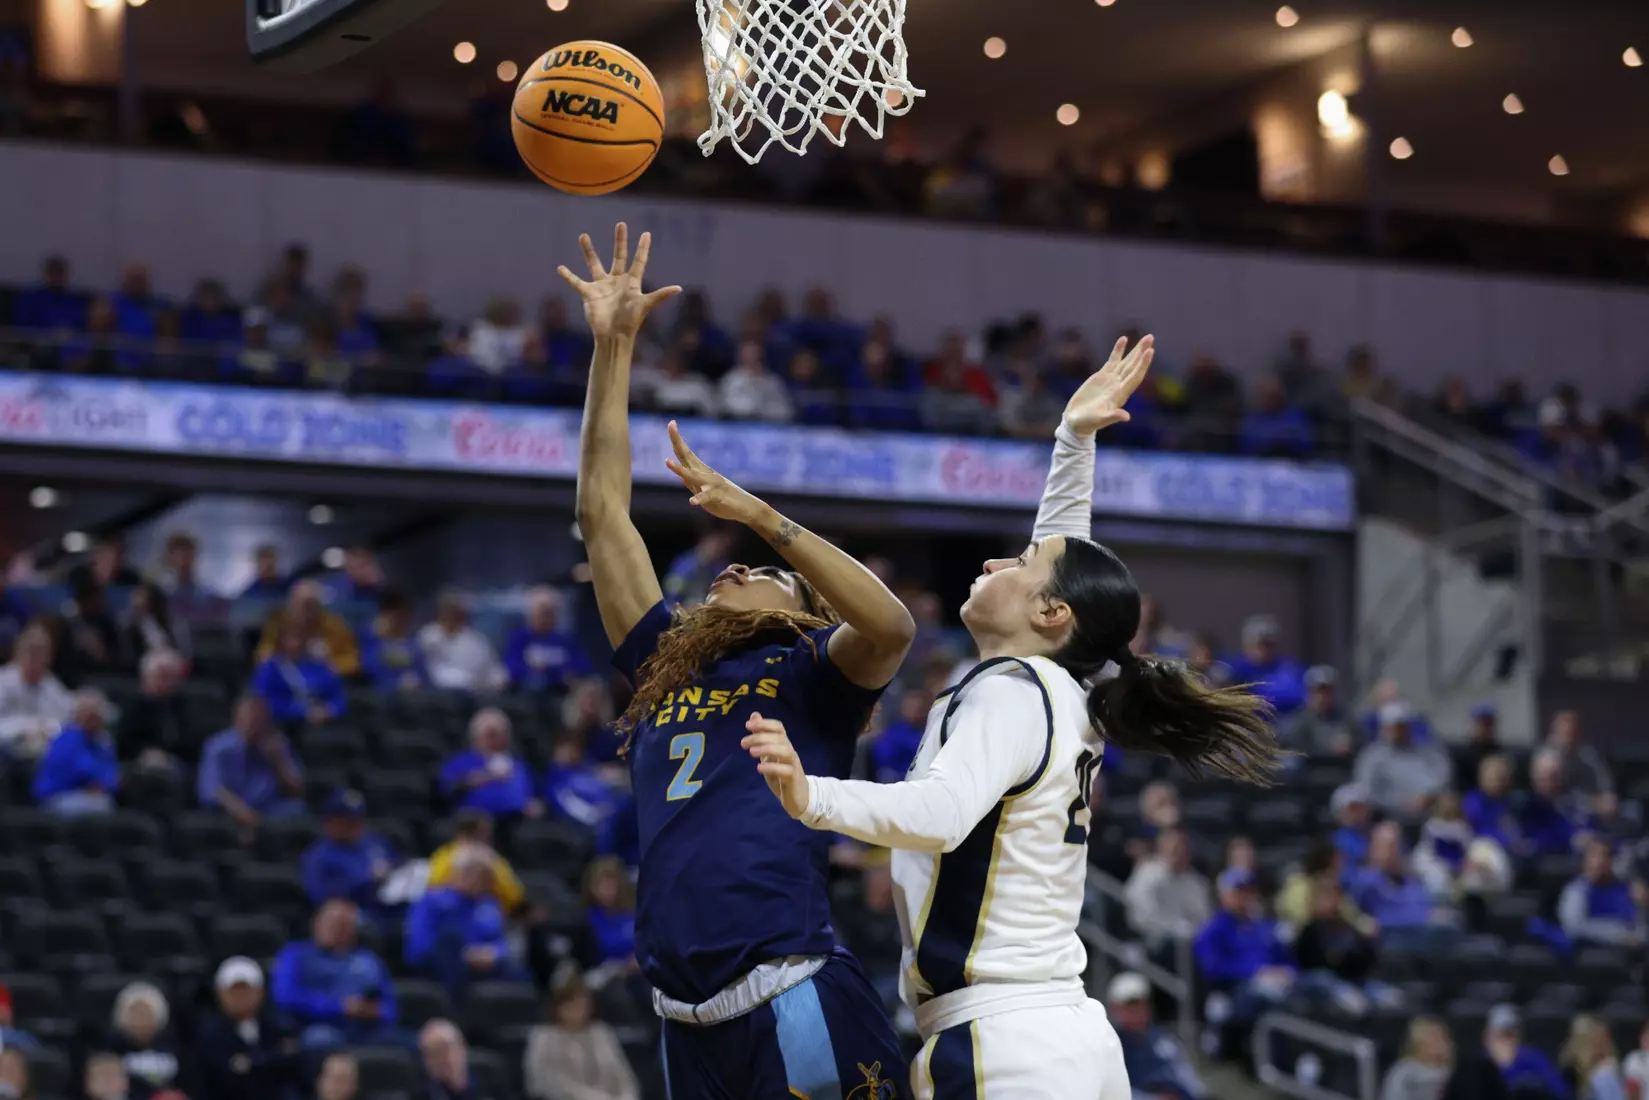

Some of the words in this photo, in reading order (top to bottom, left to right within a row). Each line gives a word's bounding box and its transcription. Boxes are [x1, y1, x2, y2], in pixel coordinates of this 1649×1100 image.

[542, 49, 642, 92] Wilson
[541, 88, 619, 124] NCAA
[650, 678, 781, 712] ANSAS
[667, 731, 706, 802] 2
